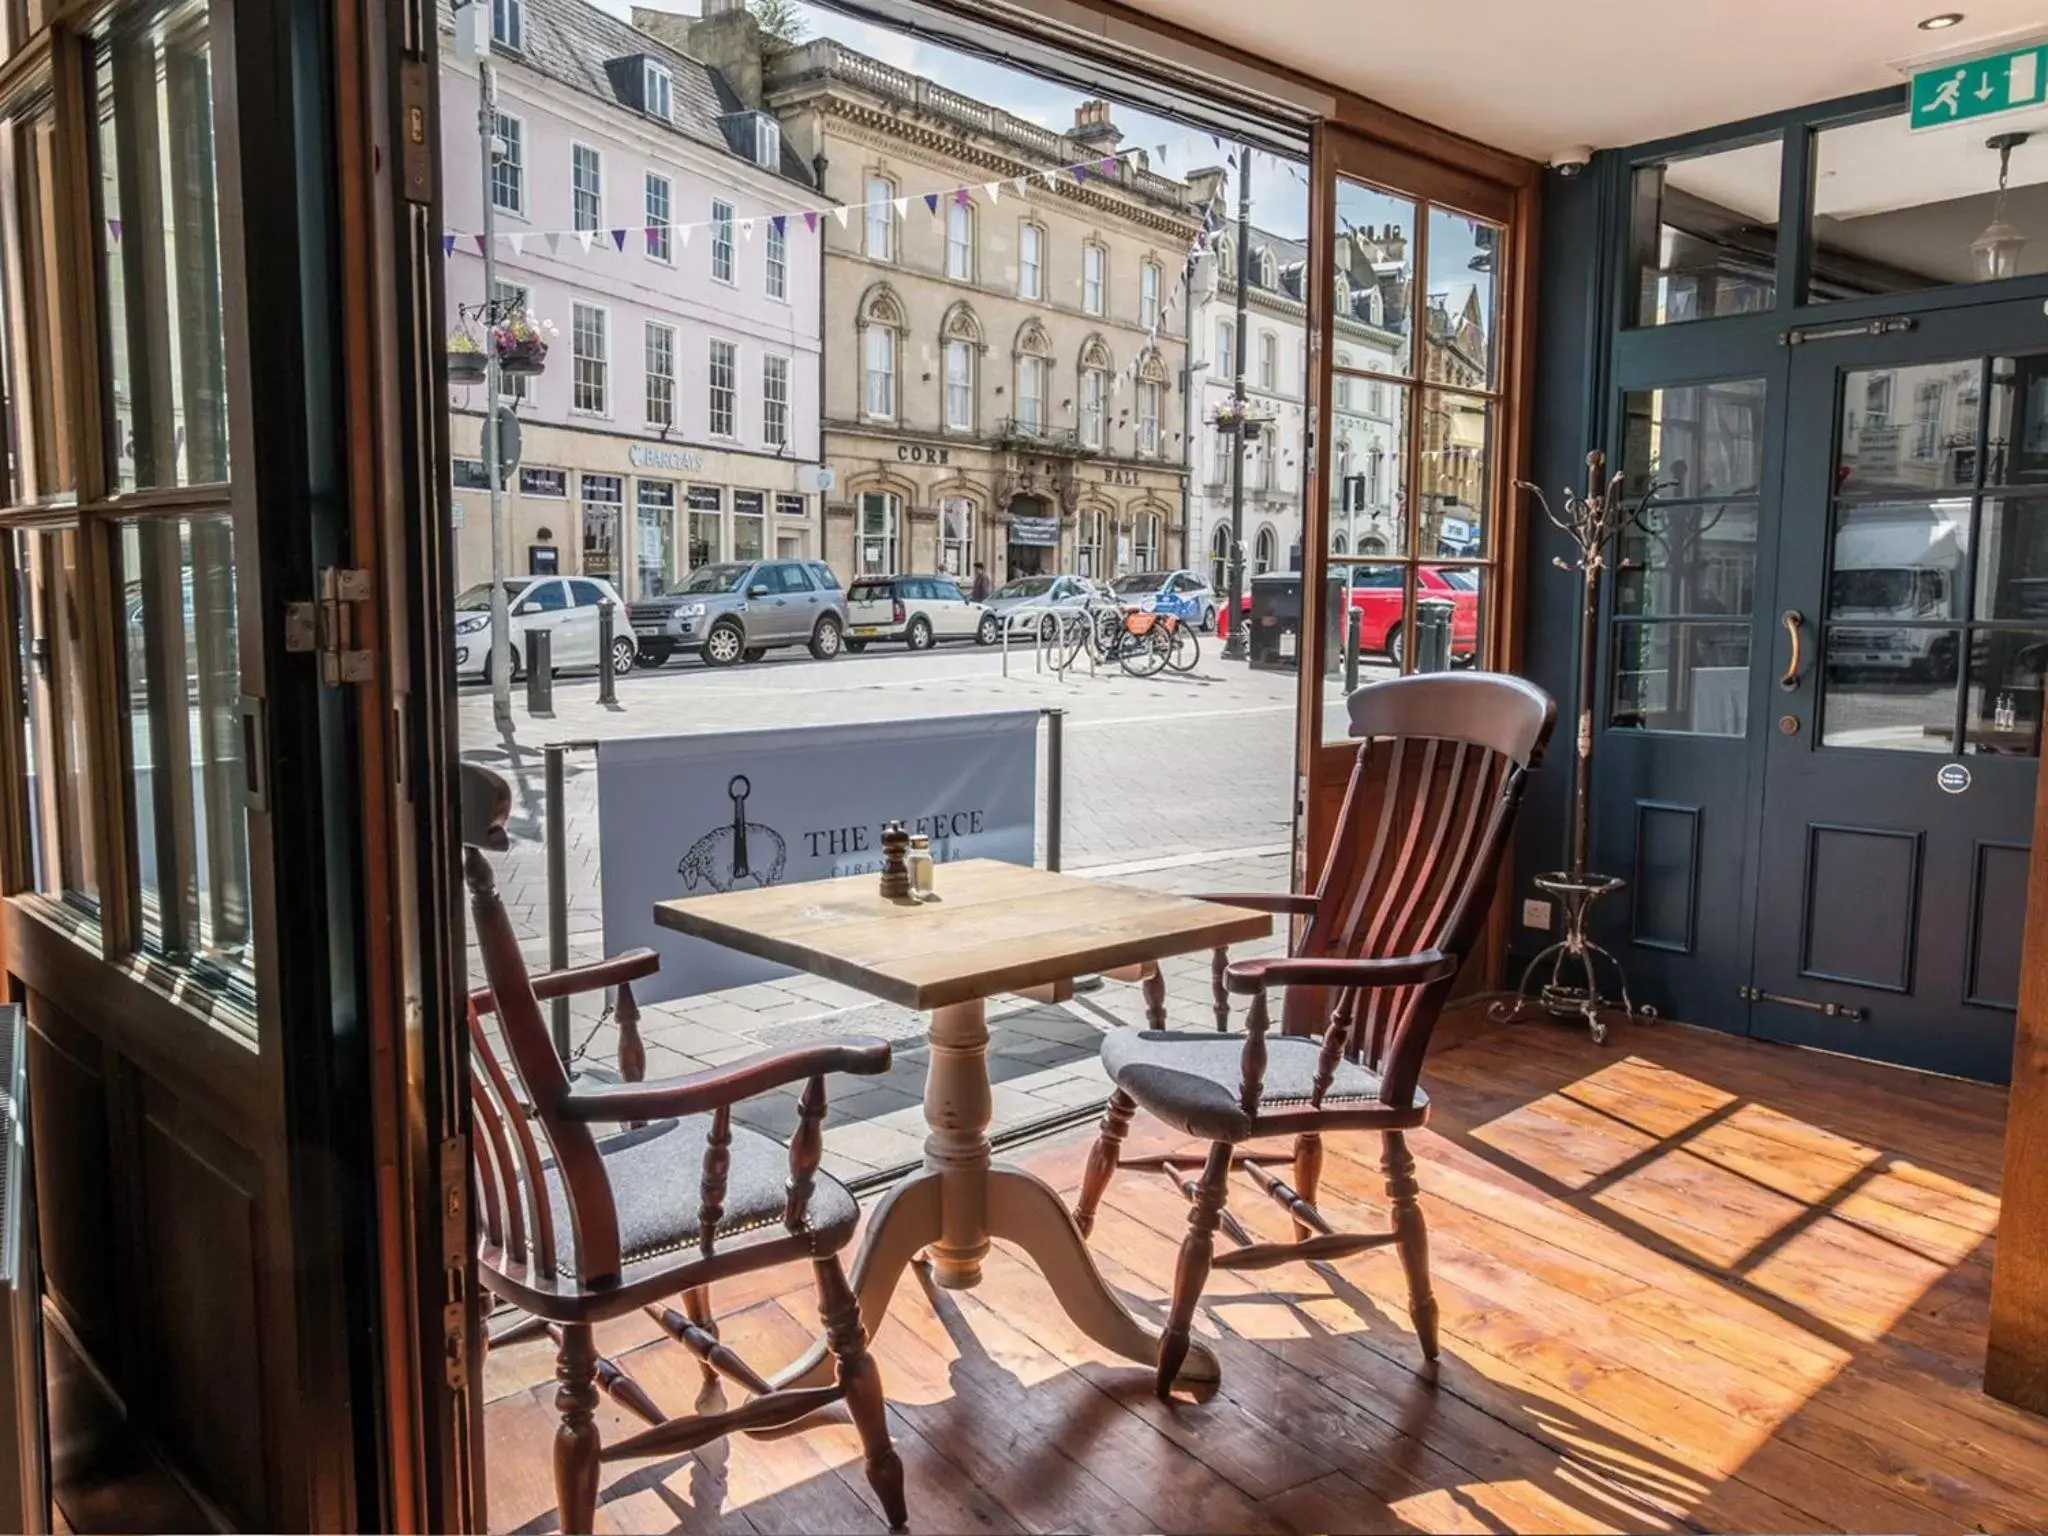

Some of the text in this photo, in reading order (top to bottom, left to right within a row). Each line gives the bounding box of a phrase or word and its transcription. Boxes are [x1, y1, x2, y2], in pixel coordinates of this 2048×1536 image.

[644, 447, 704, 472] BARCLAYS
[897, 445, 1141, 485] CORN HALL
[804, 810, 984, 857] THE EECE
